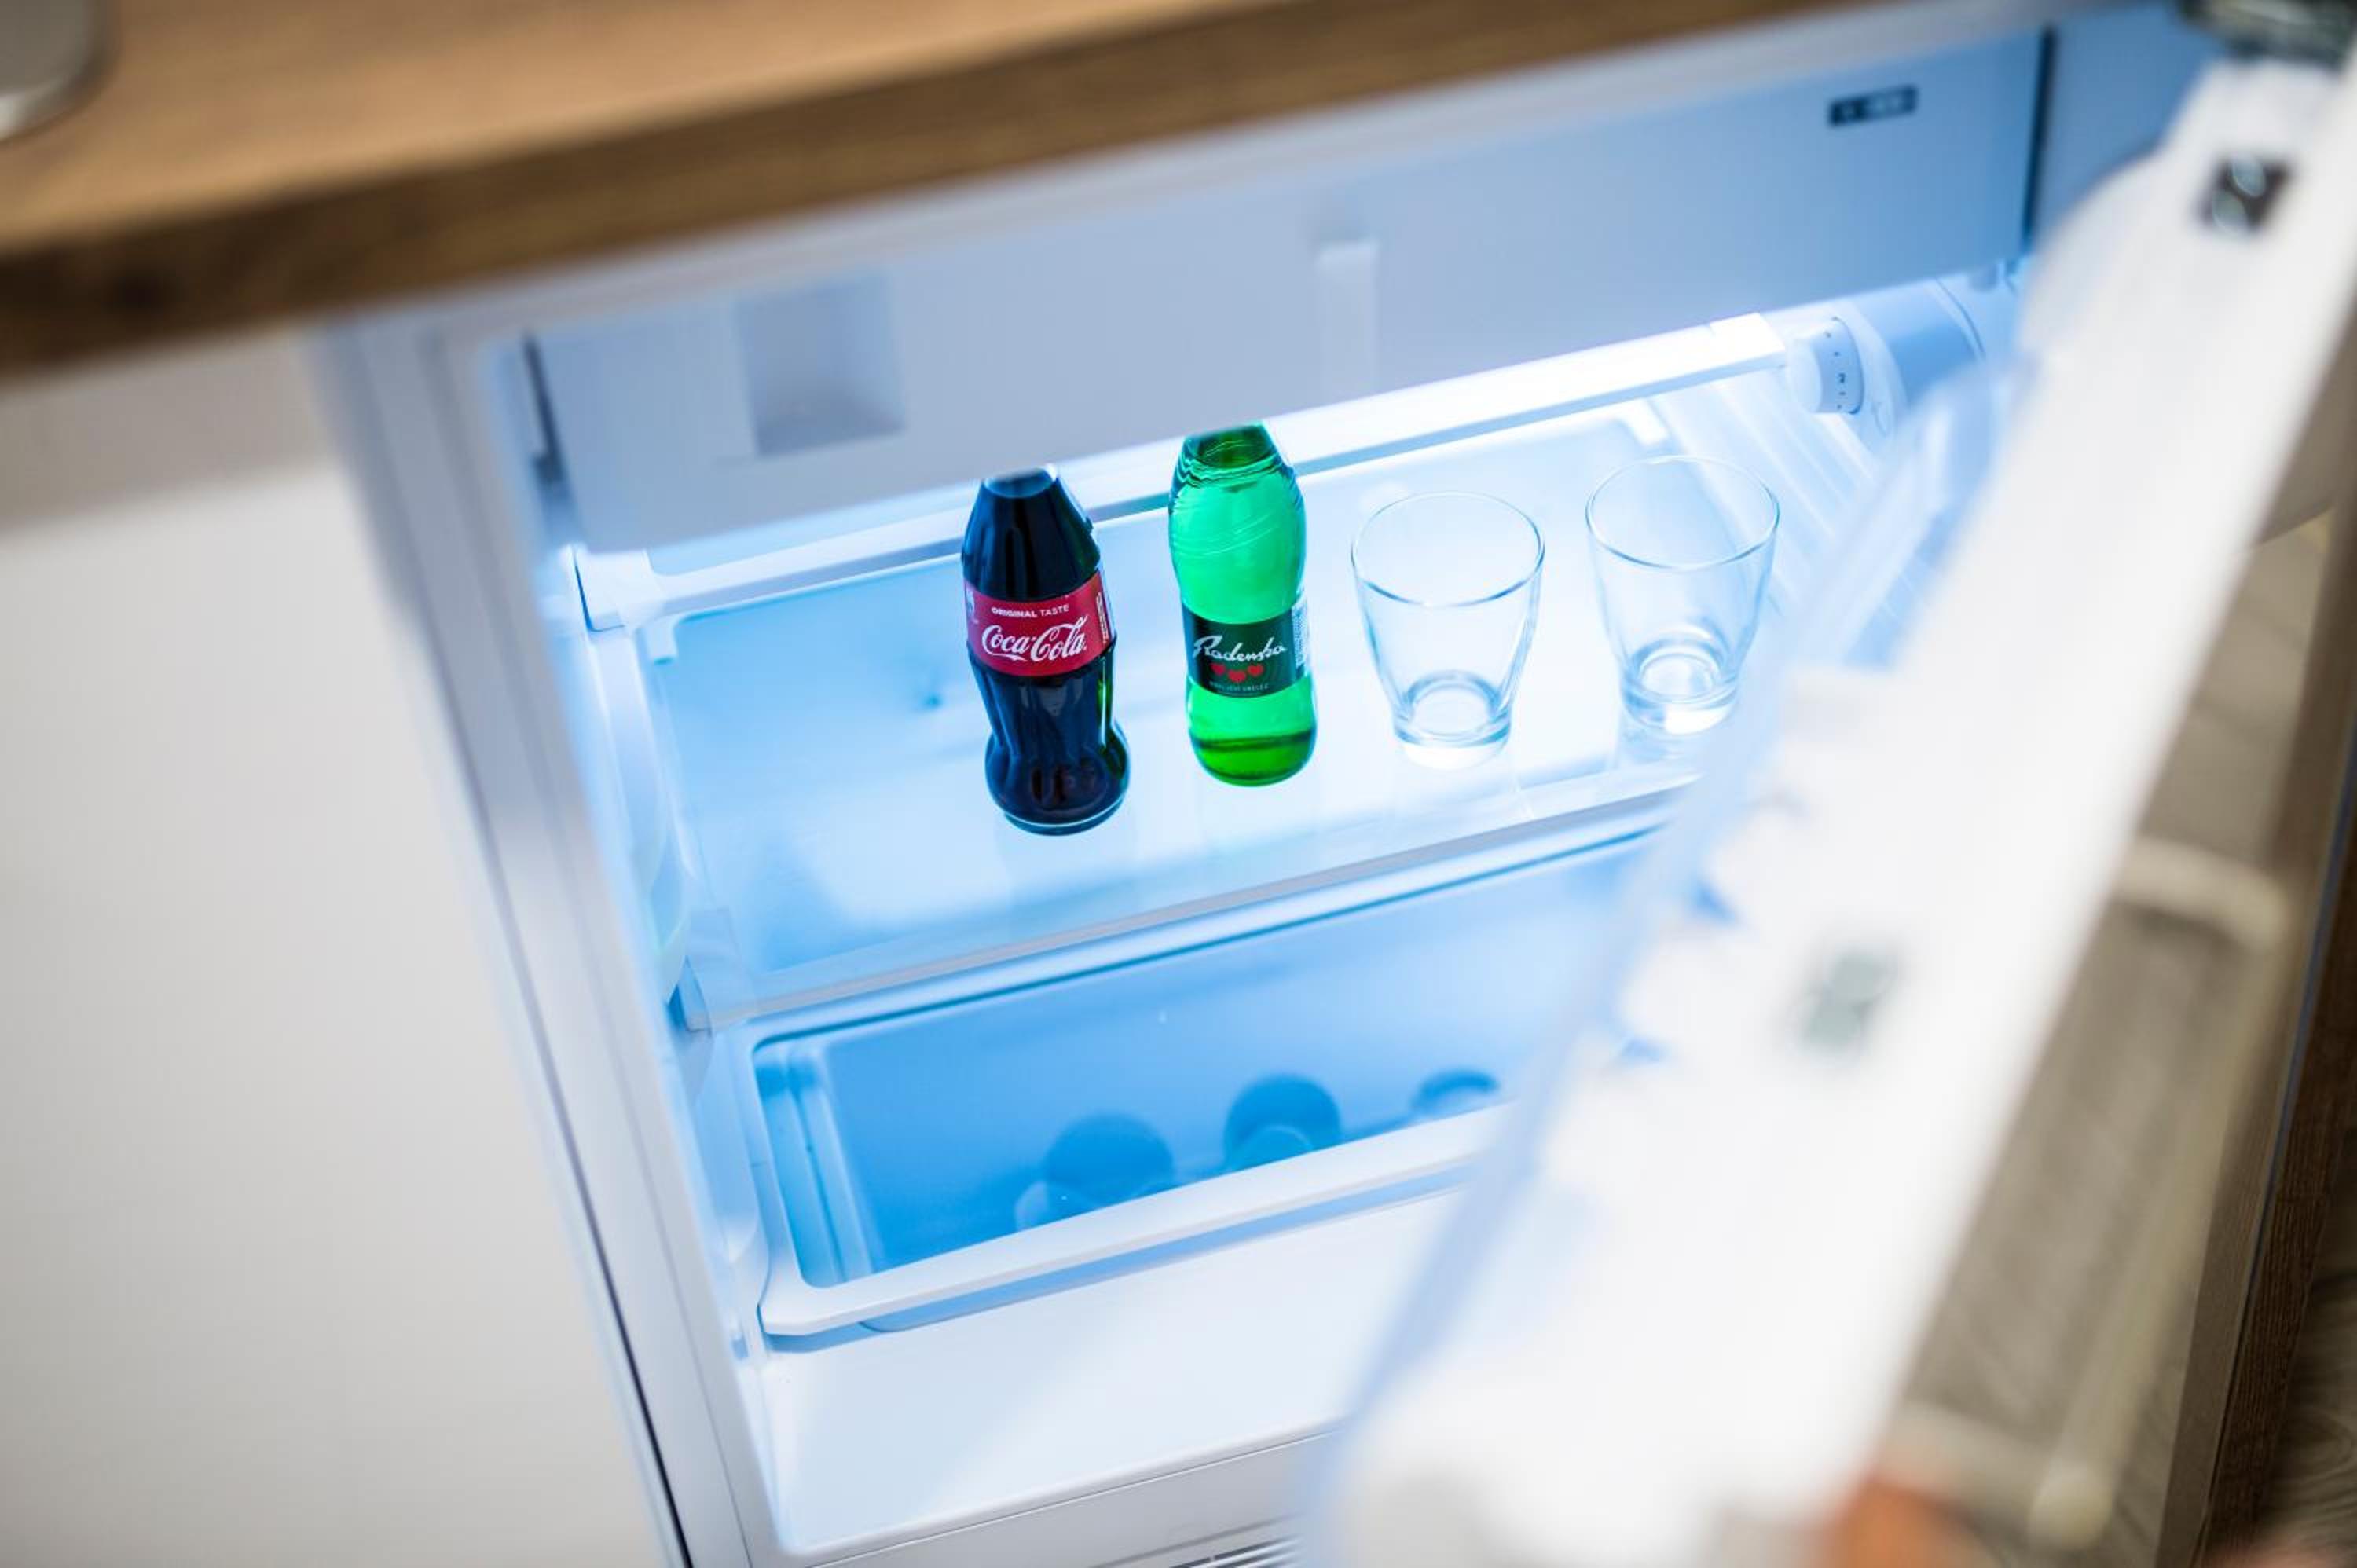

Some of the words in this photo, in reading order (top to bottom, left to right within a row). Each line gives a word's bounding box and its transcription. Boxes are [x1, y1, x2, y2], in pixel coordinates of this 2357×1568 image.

[992, 606, 1037, 618] ORIGINAL
[1039, 604, 1069, 617] TASTE
[981, 615, 1087, 662] Coca-Cola
[1193, 635, 1288, 662] Radenska
